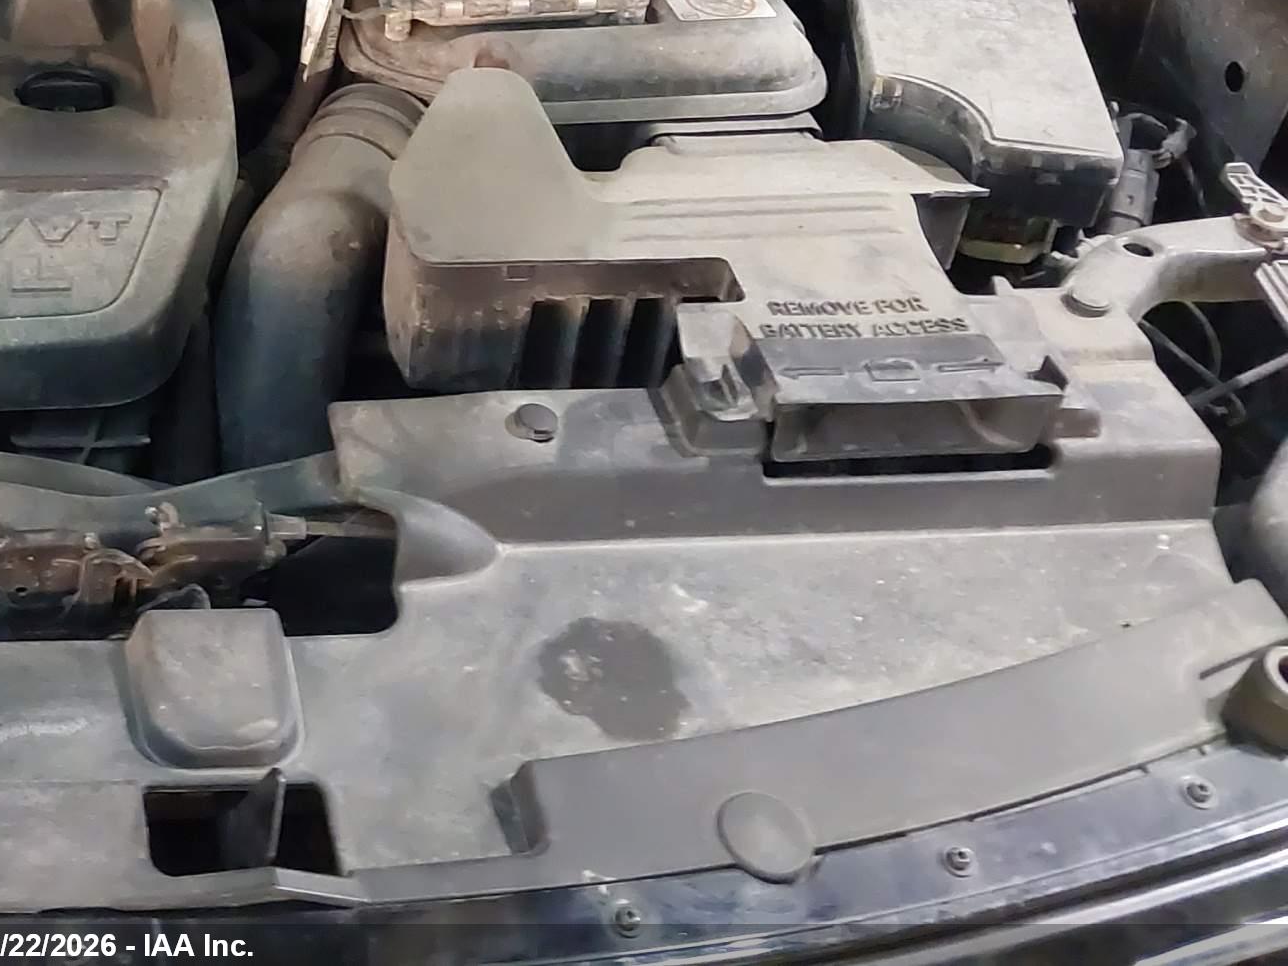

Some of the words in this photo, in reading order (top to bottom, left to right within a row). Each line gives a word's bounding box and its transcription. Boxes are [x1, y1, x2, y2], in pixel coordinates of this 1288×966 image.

[767, 300, 872, 316] REMOVE
[873, 296, 930, 314] FOR
[760, 321, 862, 339] BATTERY
[871, 317, 971, 337] ACCESS
